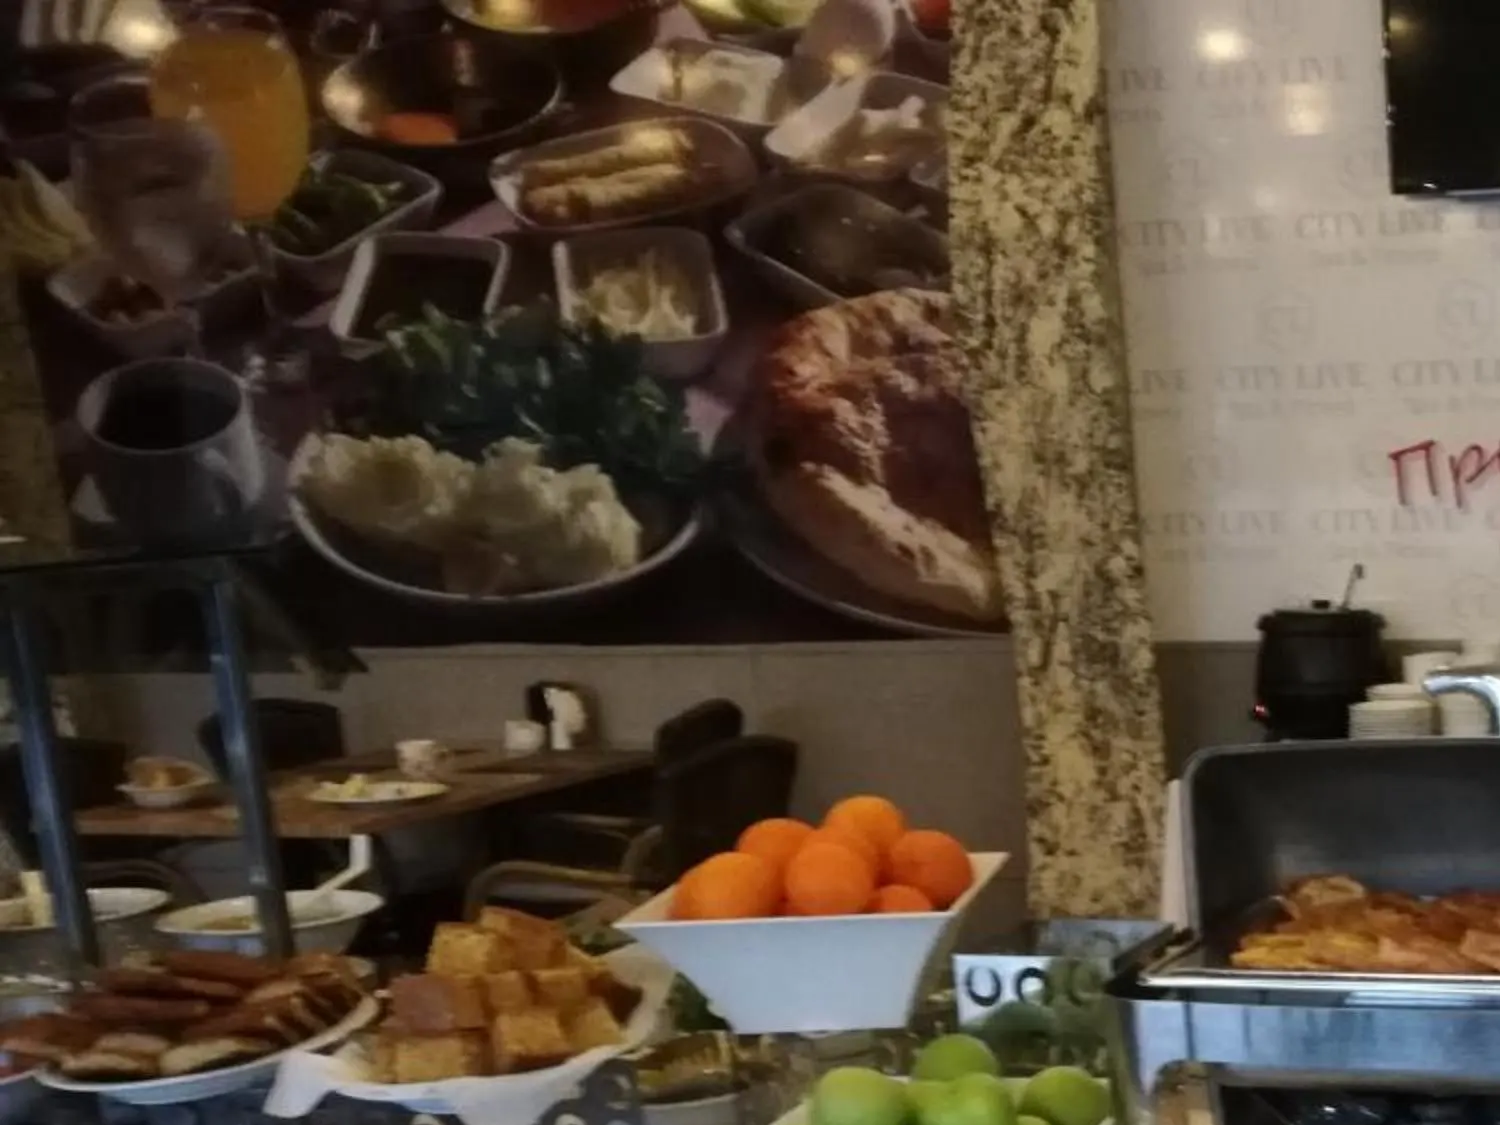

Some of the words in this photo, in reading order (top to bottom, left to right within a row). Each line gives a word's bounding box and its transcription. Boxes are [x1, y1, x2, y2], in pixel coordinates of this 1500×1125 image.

[1294, 210, 1366, 239] CITY
[1214, 362, 1285, 393] CITY
[1294, 360, 1369, 391] LIVE
[1391, 357, 1461, 387] CITY
[1218, 508, 1287, 536] LIVE
[1310, 507, 1381, 536] CITY
[1389, 504, 1460, 534] LIVE
